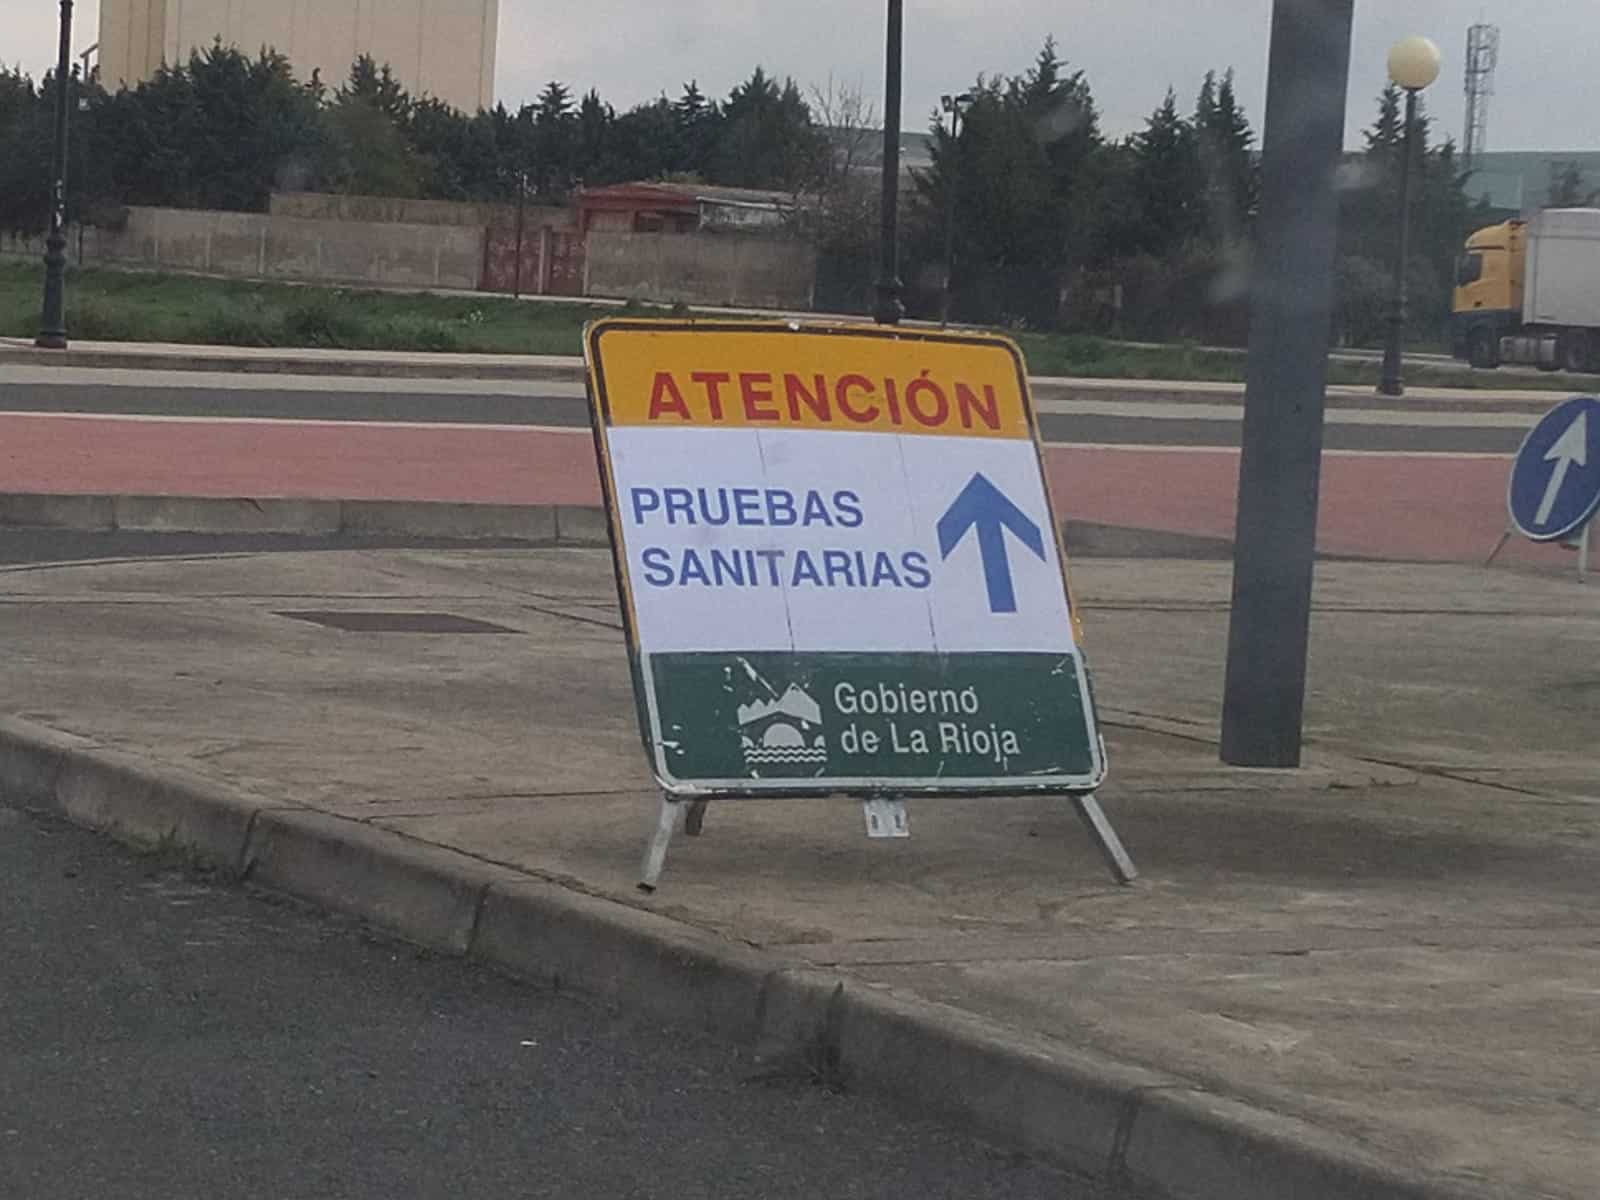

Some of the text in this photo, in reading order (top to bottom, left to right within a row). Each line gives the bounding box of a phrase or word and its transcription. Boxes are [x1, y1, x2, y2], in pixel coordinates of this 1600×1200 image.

[647, 369, 1001, 430] ATENCIÓN
[630, 487, 863, 528] PRUEBAS
[642, 548, 932, 589] SANITARIAS
[834, 682, 979, 714] Gobierno
[841, 722, 1020, 762] de La Rioja
